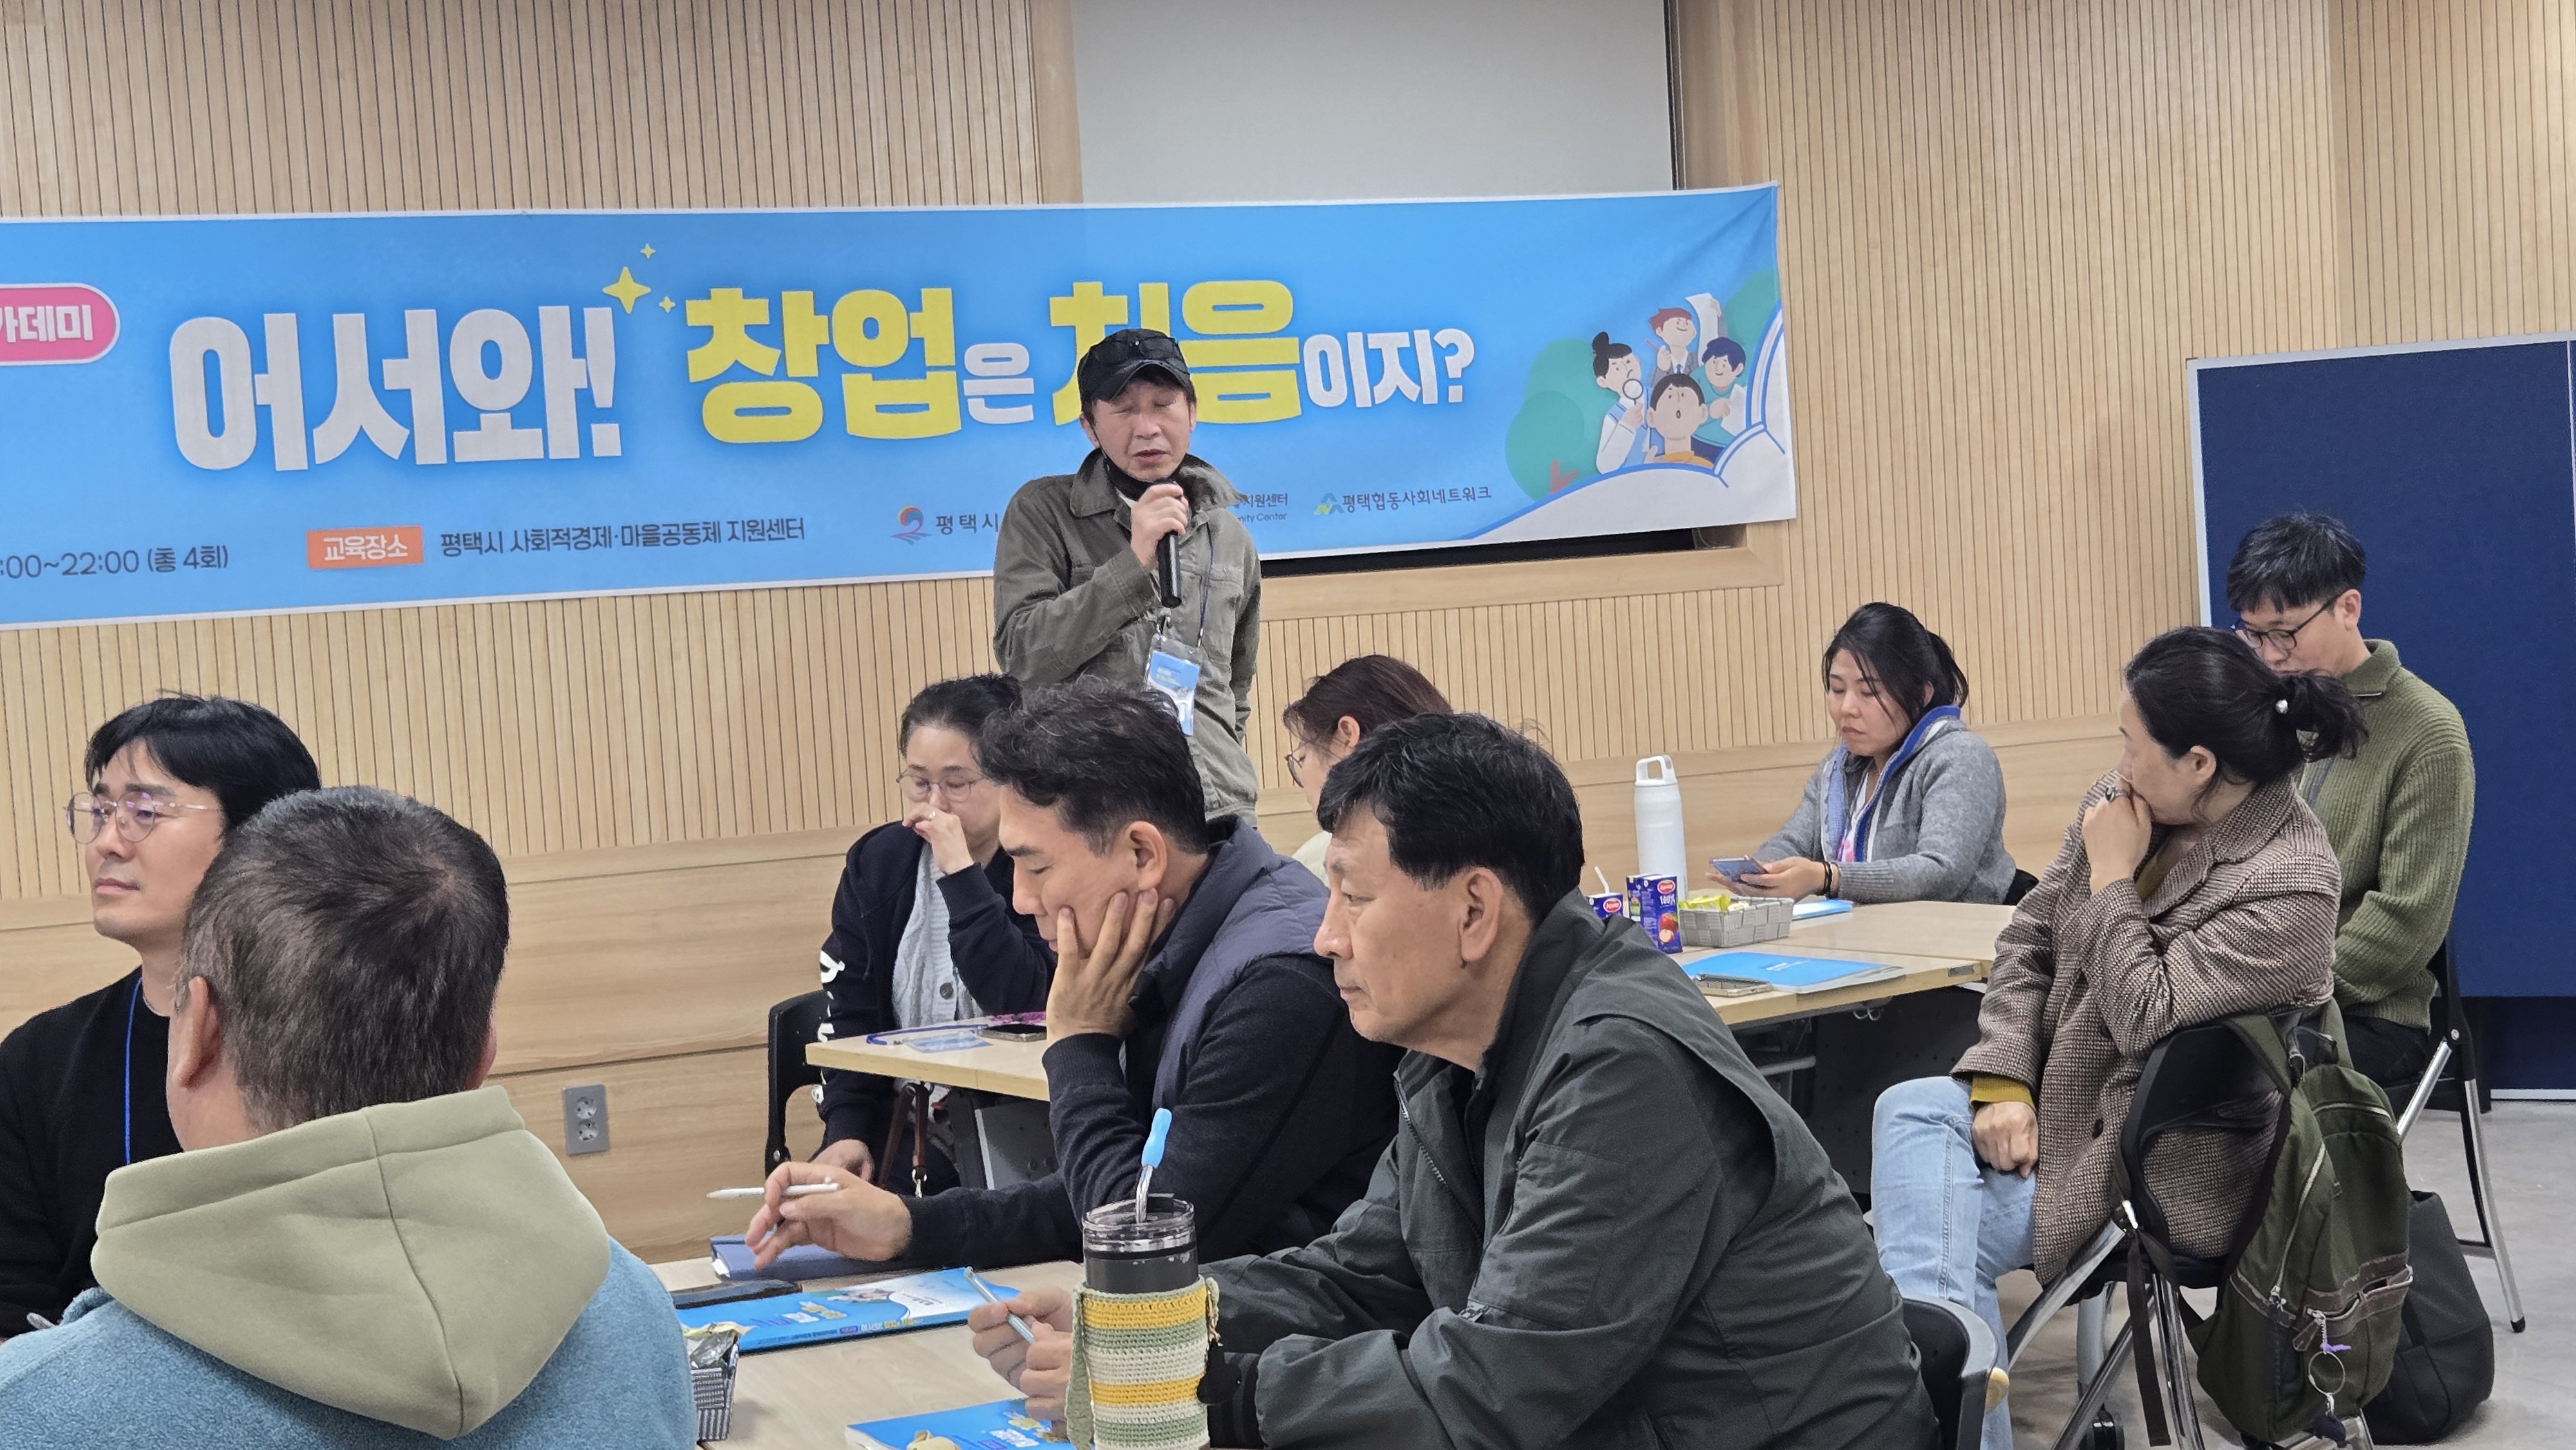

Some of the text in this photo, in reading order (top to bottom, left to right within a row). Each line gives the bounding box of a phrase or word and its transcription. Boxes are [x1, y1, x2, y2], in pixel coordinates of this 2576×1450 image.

[169, 306, 622, 471] 어서와!
[685, 287, 1035, 444] 창업은
[1342, 486, 1492, 513] 평택협동사회네트워크
[440, 531, 504, 558] 평택시
[726, 517, 805, 542] 지원센터
[936, 513, 998, 535] 평택시
[147, 548, 176, 572] (총
[183, 545, 229, 569] 4회)
[323, 534, 408, 561] 교육장소
